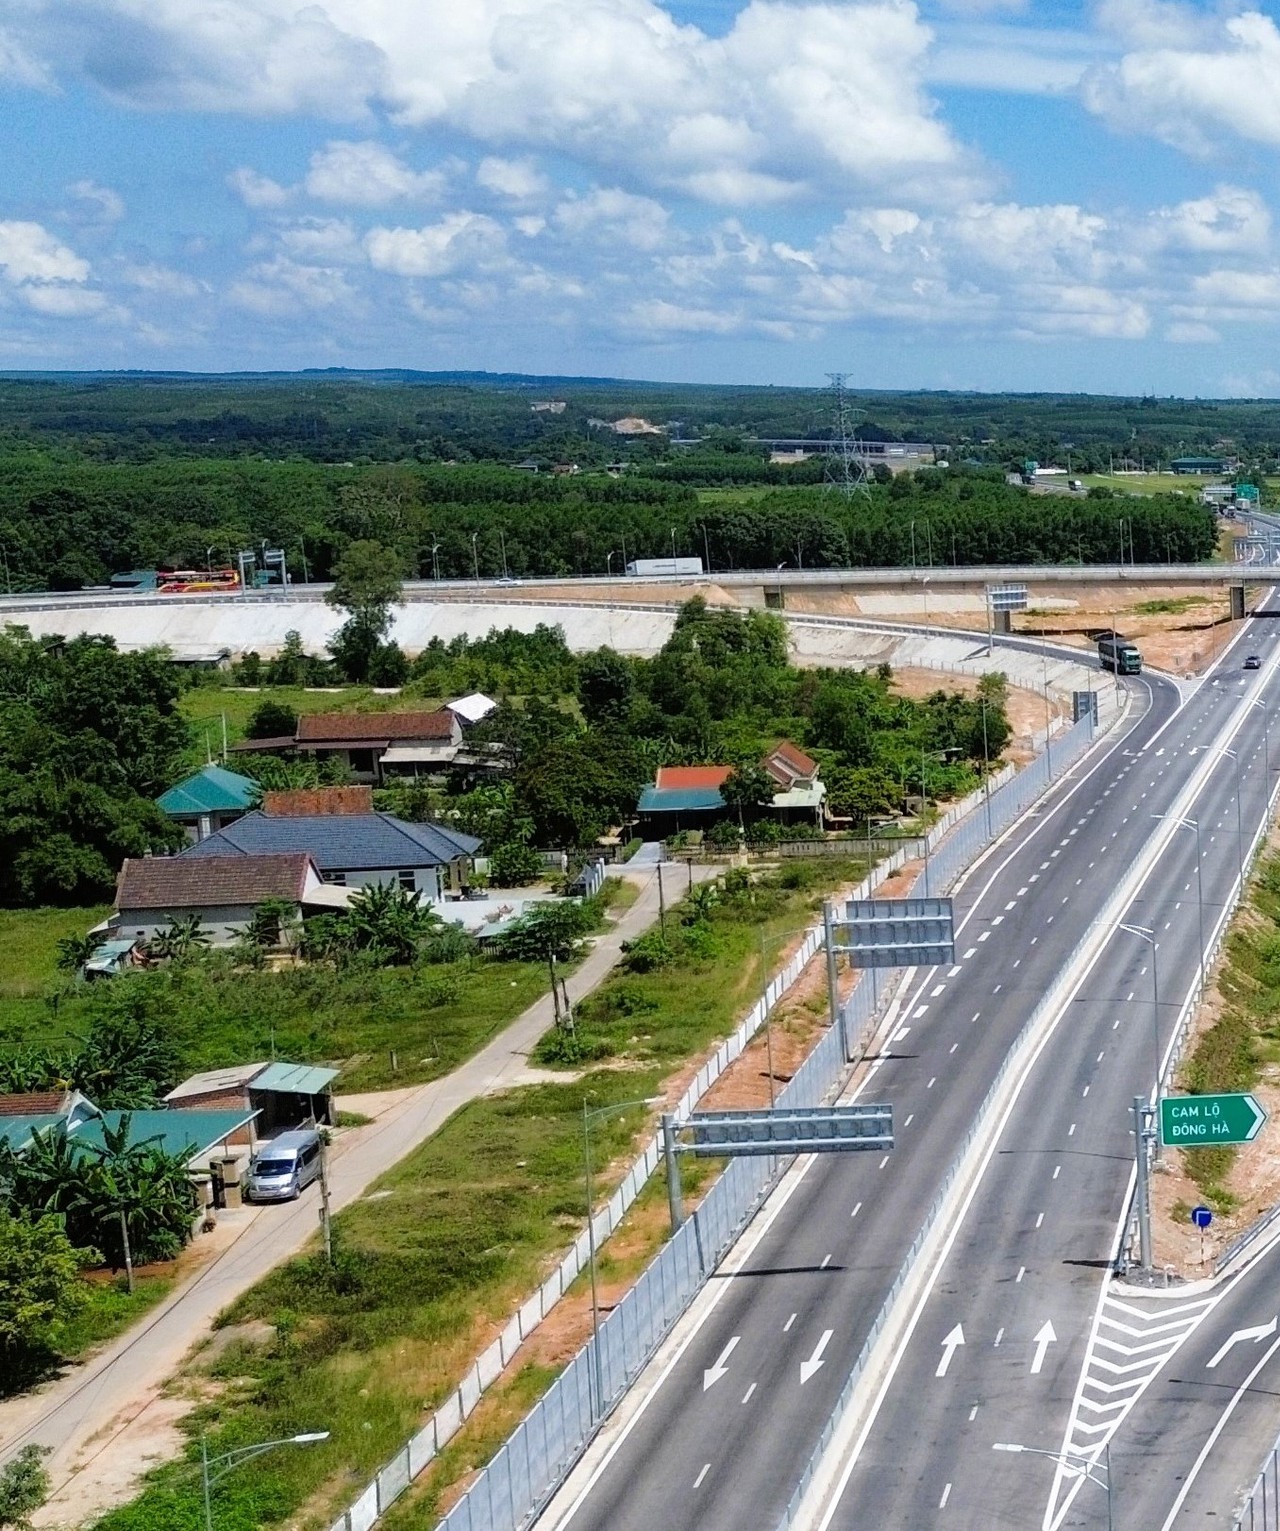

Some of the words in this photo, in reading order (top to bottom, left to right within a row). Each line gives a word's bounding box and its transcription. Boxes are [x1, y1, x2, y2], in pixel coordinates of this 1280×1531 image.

[1171, 1106, 1199, 1118] CAM
[1204, 1102, 1220, 1119] LỘ
[1172, 1122, 1207, 1136] ĐÔNG
[1211, 1120, 1230, 1134] HÀ
